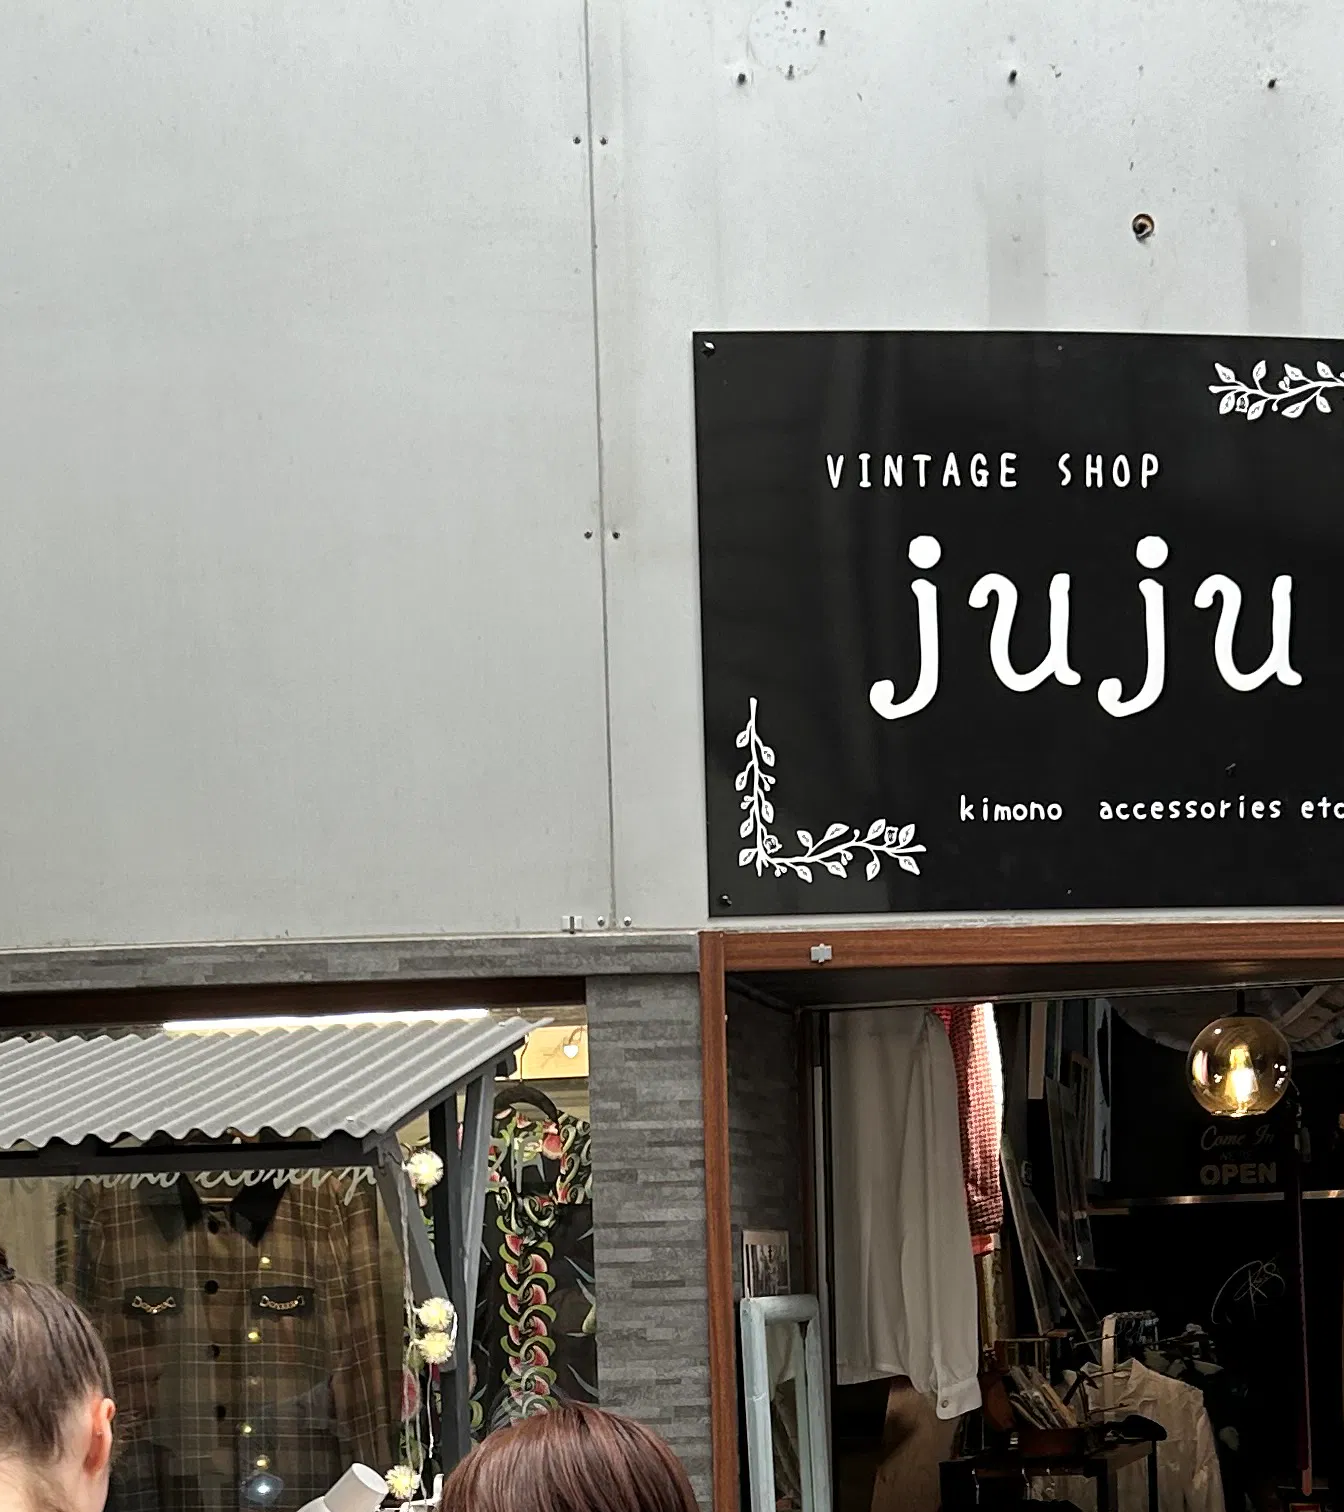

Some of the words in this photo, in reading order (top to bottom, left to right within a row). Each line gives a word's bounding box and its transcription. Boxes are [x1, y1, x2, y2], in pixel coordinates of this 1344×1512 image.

[826, 453, 1019, 489] VINTAGE
[1057, 453, 1161, 489] SHOP
[869, 535, 1303, 720] juju
[959, 794, 1063, 822] kimono
[1099, 795, 1281, 821] accessories
[1200, 1161, 1277, 1186] OPEN
